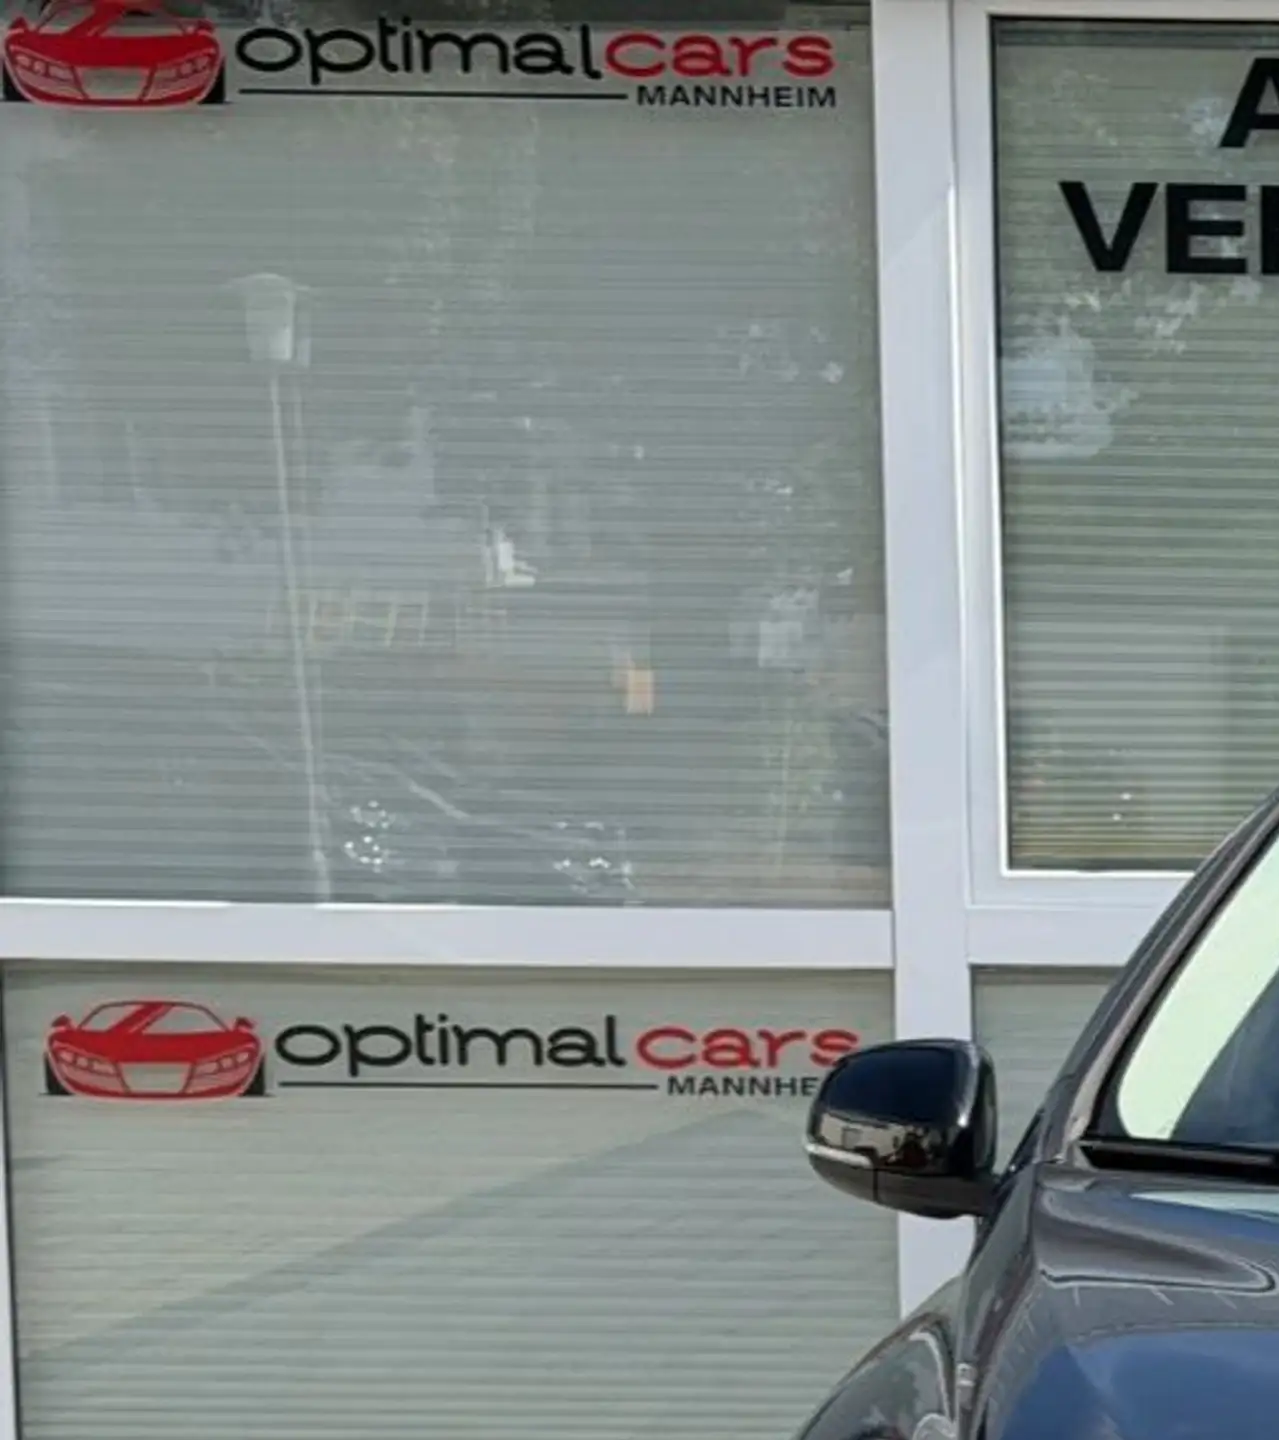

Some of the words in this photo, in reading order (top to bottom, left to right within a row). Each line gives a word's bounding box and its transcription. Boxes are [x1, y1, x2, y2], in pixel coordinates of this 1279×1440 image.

[234, 17, 604, 85] optimal
[604, 30, 836, 80] cars
[637, 85, 837, 108] MANNHEIM
[273, 1013, 627, 1078] optimal
[635, 1023, 862, 1071] cars
